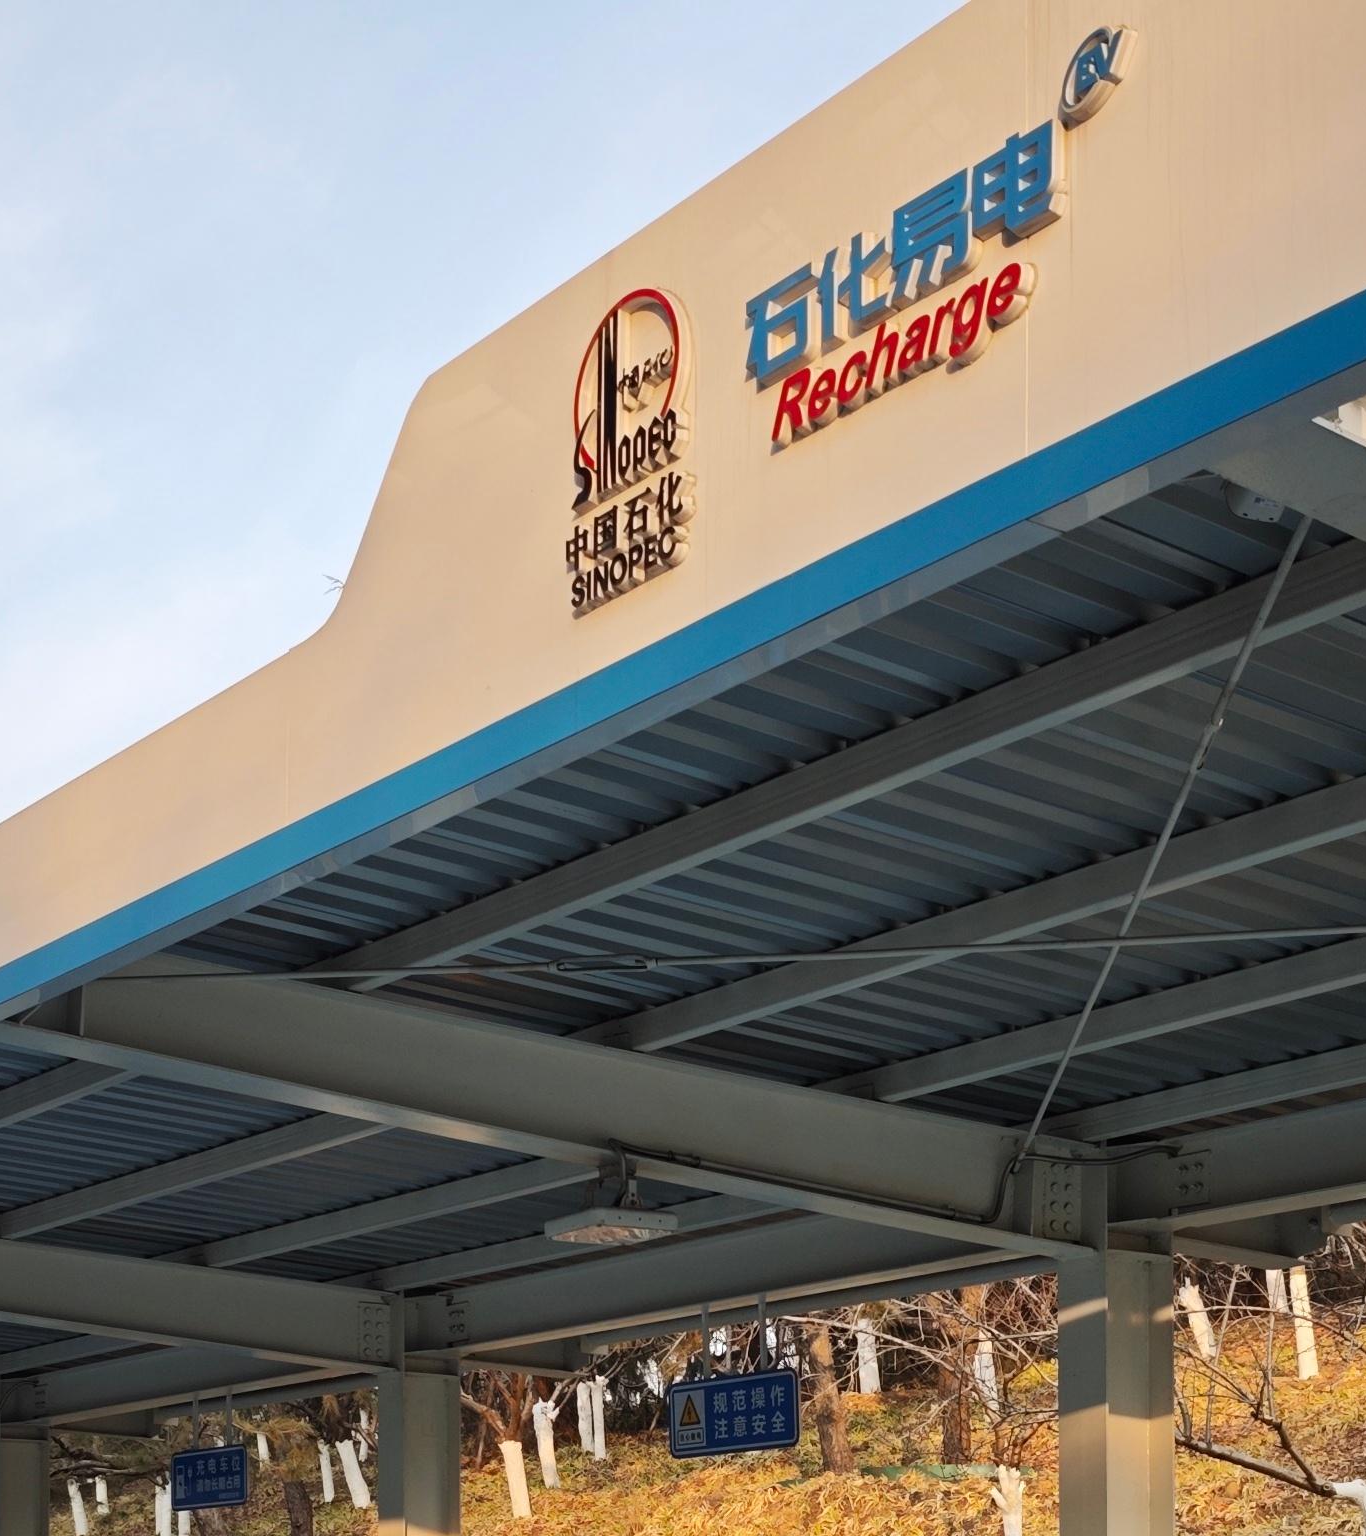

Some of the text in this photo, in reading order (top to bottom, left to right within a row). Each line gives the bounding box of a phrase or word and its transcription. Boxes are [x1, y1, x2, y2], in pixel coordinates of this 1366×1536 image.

[745, 119, 1056, 383] 石化易电
[771, 262, 1023, 442] Recharge
[566, 472, 682, 573] 中国石化
[571, 526, 676, 608] SINOPEC
[713, 1384, 785, 1415] 规范操作
[714, 1411, 785, 1441] 注意安全
